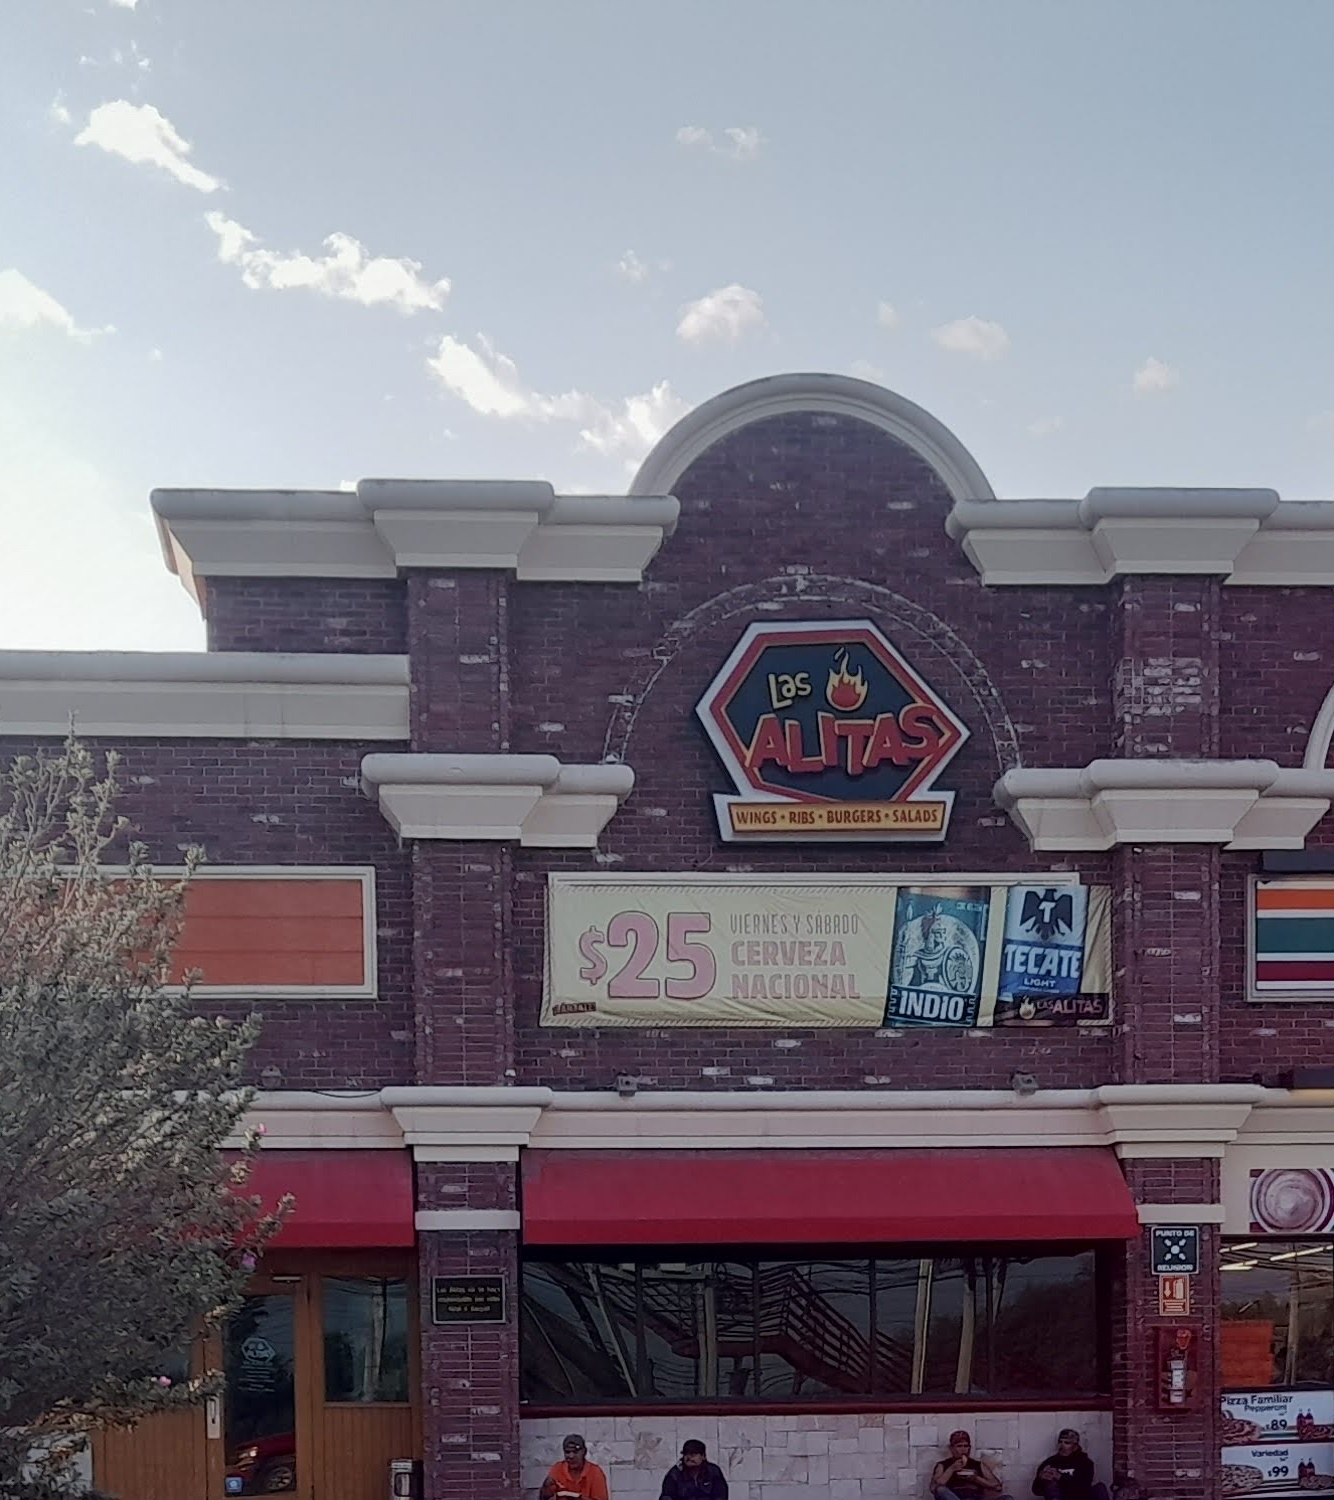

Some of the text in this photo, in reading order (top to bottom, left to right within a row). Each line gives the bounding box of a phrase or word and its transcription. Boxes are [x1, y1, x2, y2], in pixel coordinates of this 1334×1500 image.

[745, 703, 943, 776] ALITAS
[736, 808, 938, 825] WINGS RIBS BURGERS SALADS
[729, 913, 788, 935] VIERNES
[793, 913, 801, 935] Y
[578, 909, 717, 1001] $25
[730, 940, 847, 967] CERVEZA
[1004, 943, 1084, 979] TECATE
[730, 973, 861, 1000] NACIONAL
[1023, 977, 1057, 989] LIGHT
[898, 993, 965, 1022] INDIO
[1053, 997, 1104, 1016] ALITAS
[1221, 1394, 1294, 1406] Pizza Familiar
[1251, 1449, 1289, 1458] Variedad
